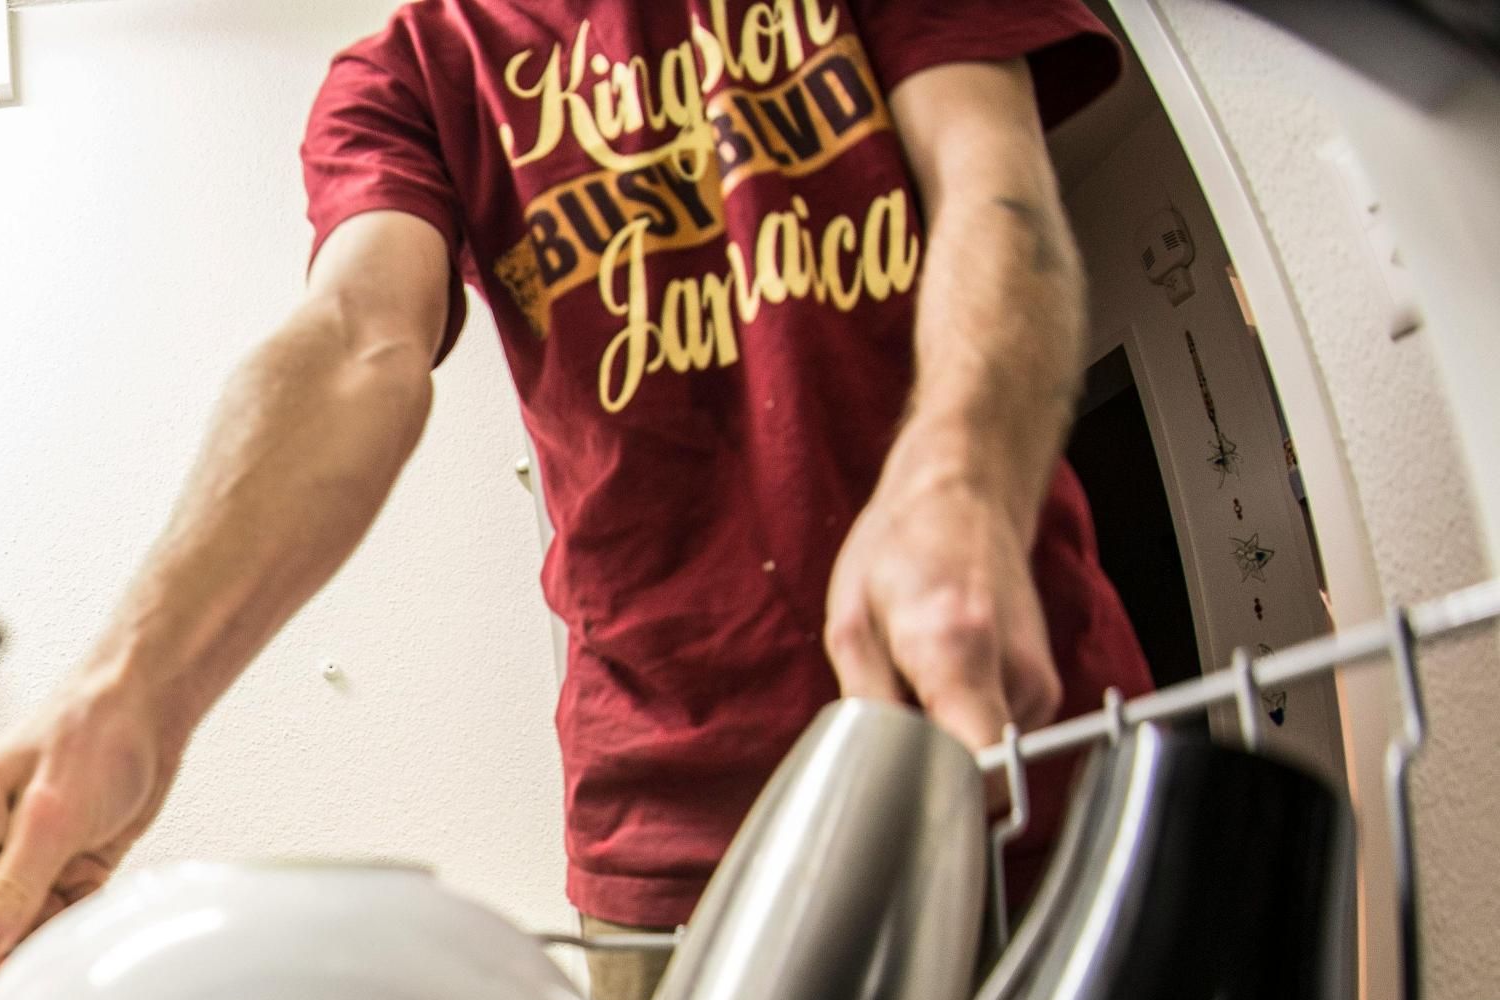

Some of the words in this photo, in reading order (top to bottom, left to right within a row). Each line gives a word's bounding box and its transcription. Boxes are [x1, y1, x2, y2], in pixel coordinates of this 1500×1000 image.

[528, 161, 716, 288] BUSY
[711, 53, 875, 177] BLVD
[598, 187, 919, 414] Jamaica
